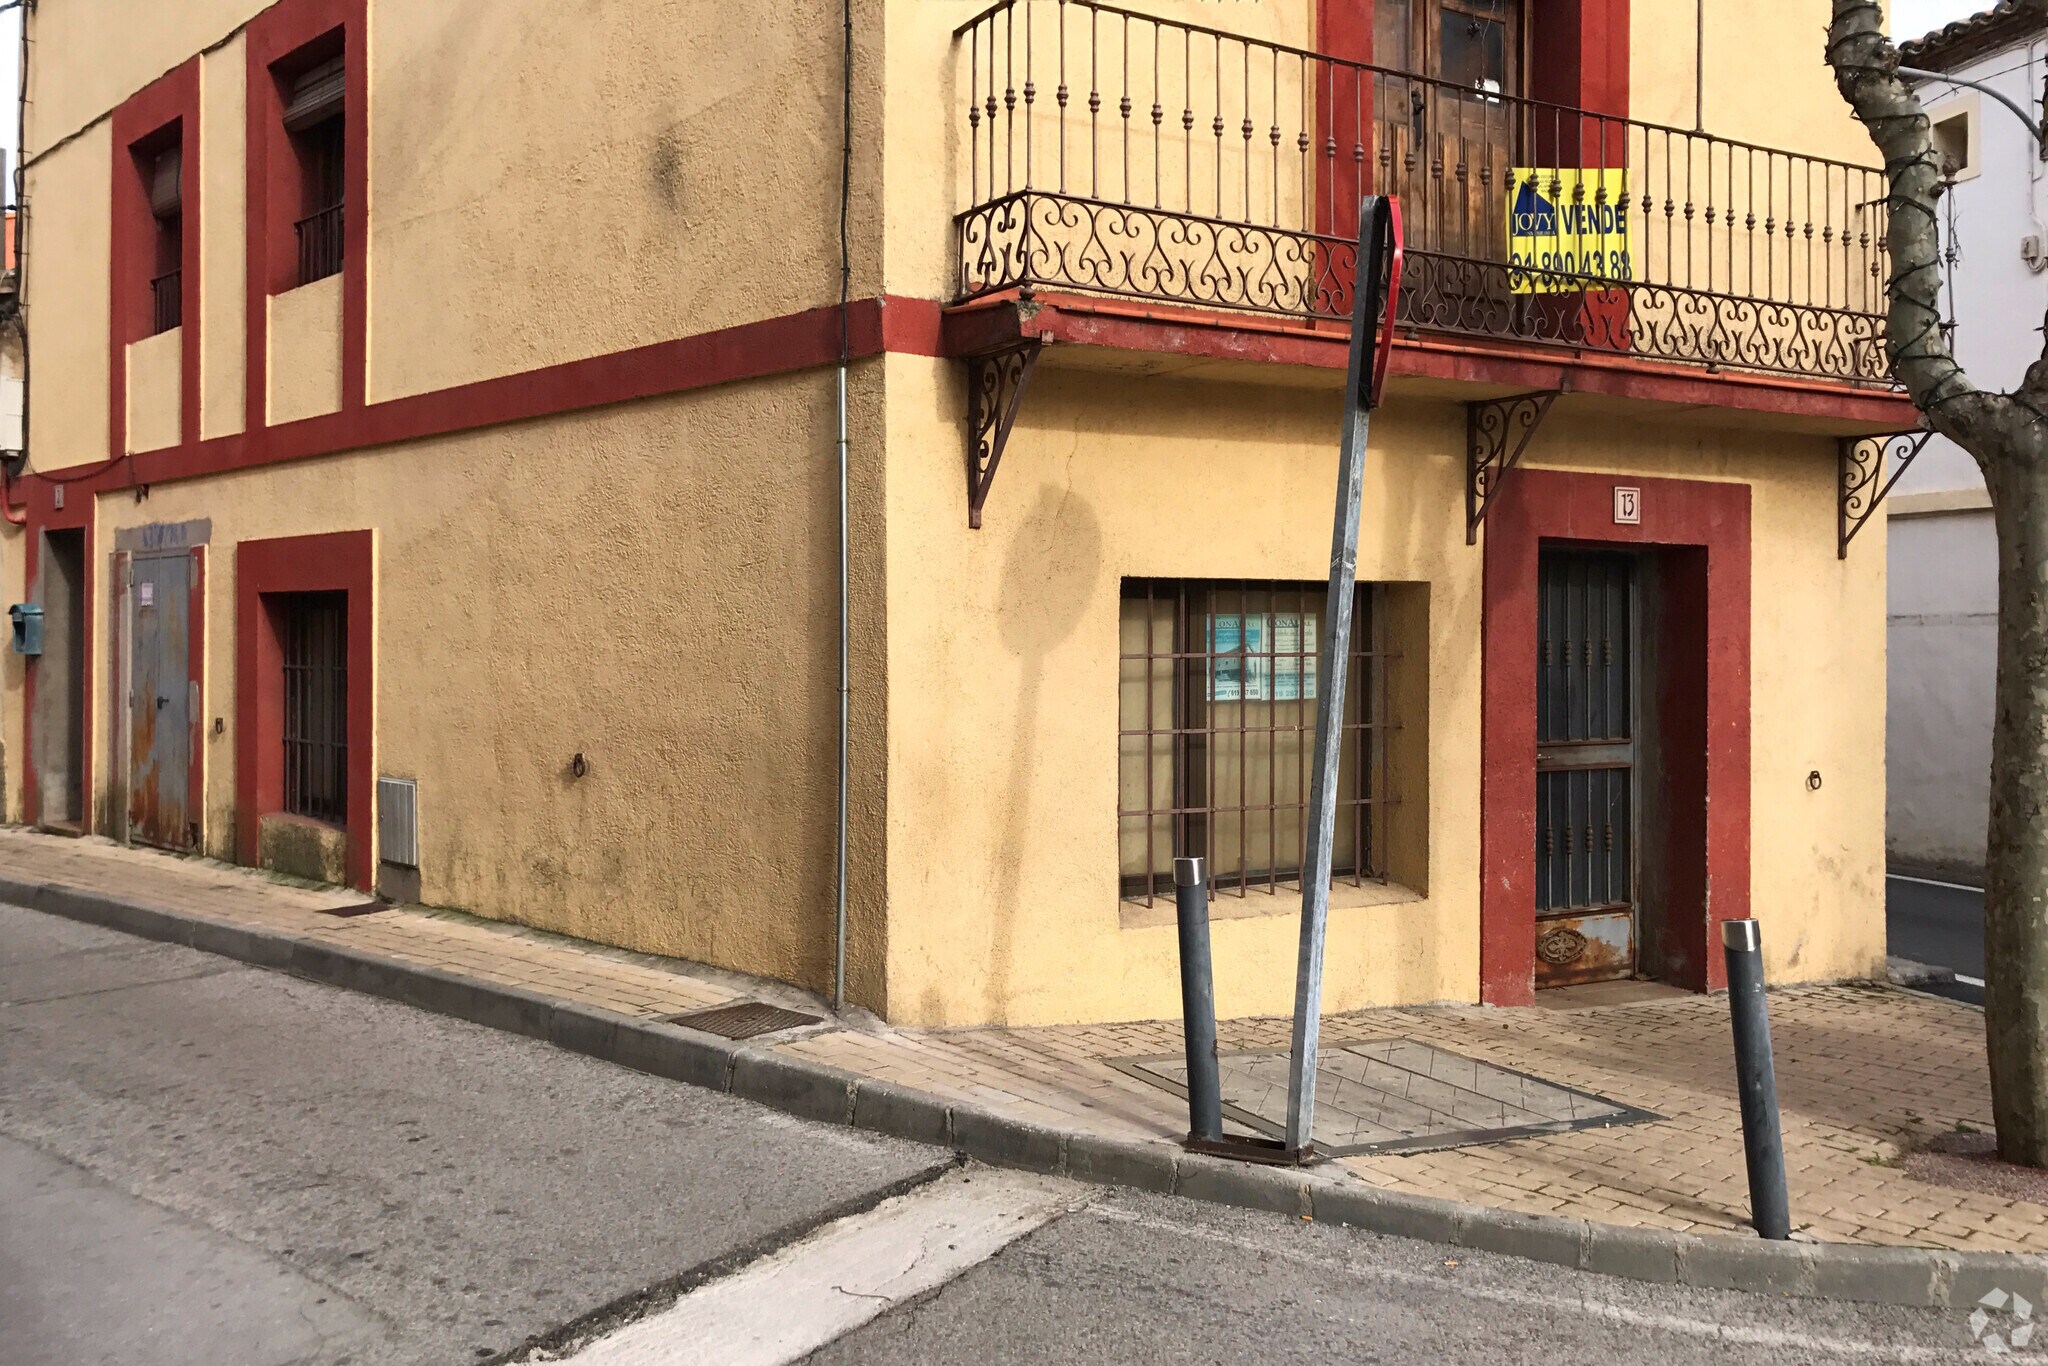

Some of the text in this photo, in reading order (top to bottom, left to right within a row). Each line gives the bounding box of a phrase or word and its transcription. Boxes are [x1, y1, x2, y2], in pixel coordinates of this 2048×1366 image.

[1513, 212, 1555, 236] JOVY
[1561, 204, 1626, 235] VENDE
[1541, 250, 1575, 286] 890
[1582, 250, 1604, 280] 43
[1609, 250, 1632, 281] 88
[1621, 493, 1634, 516] 13
